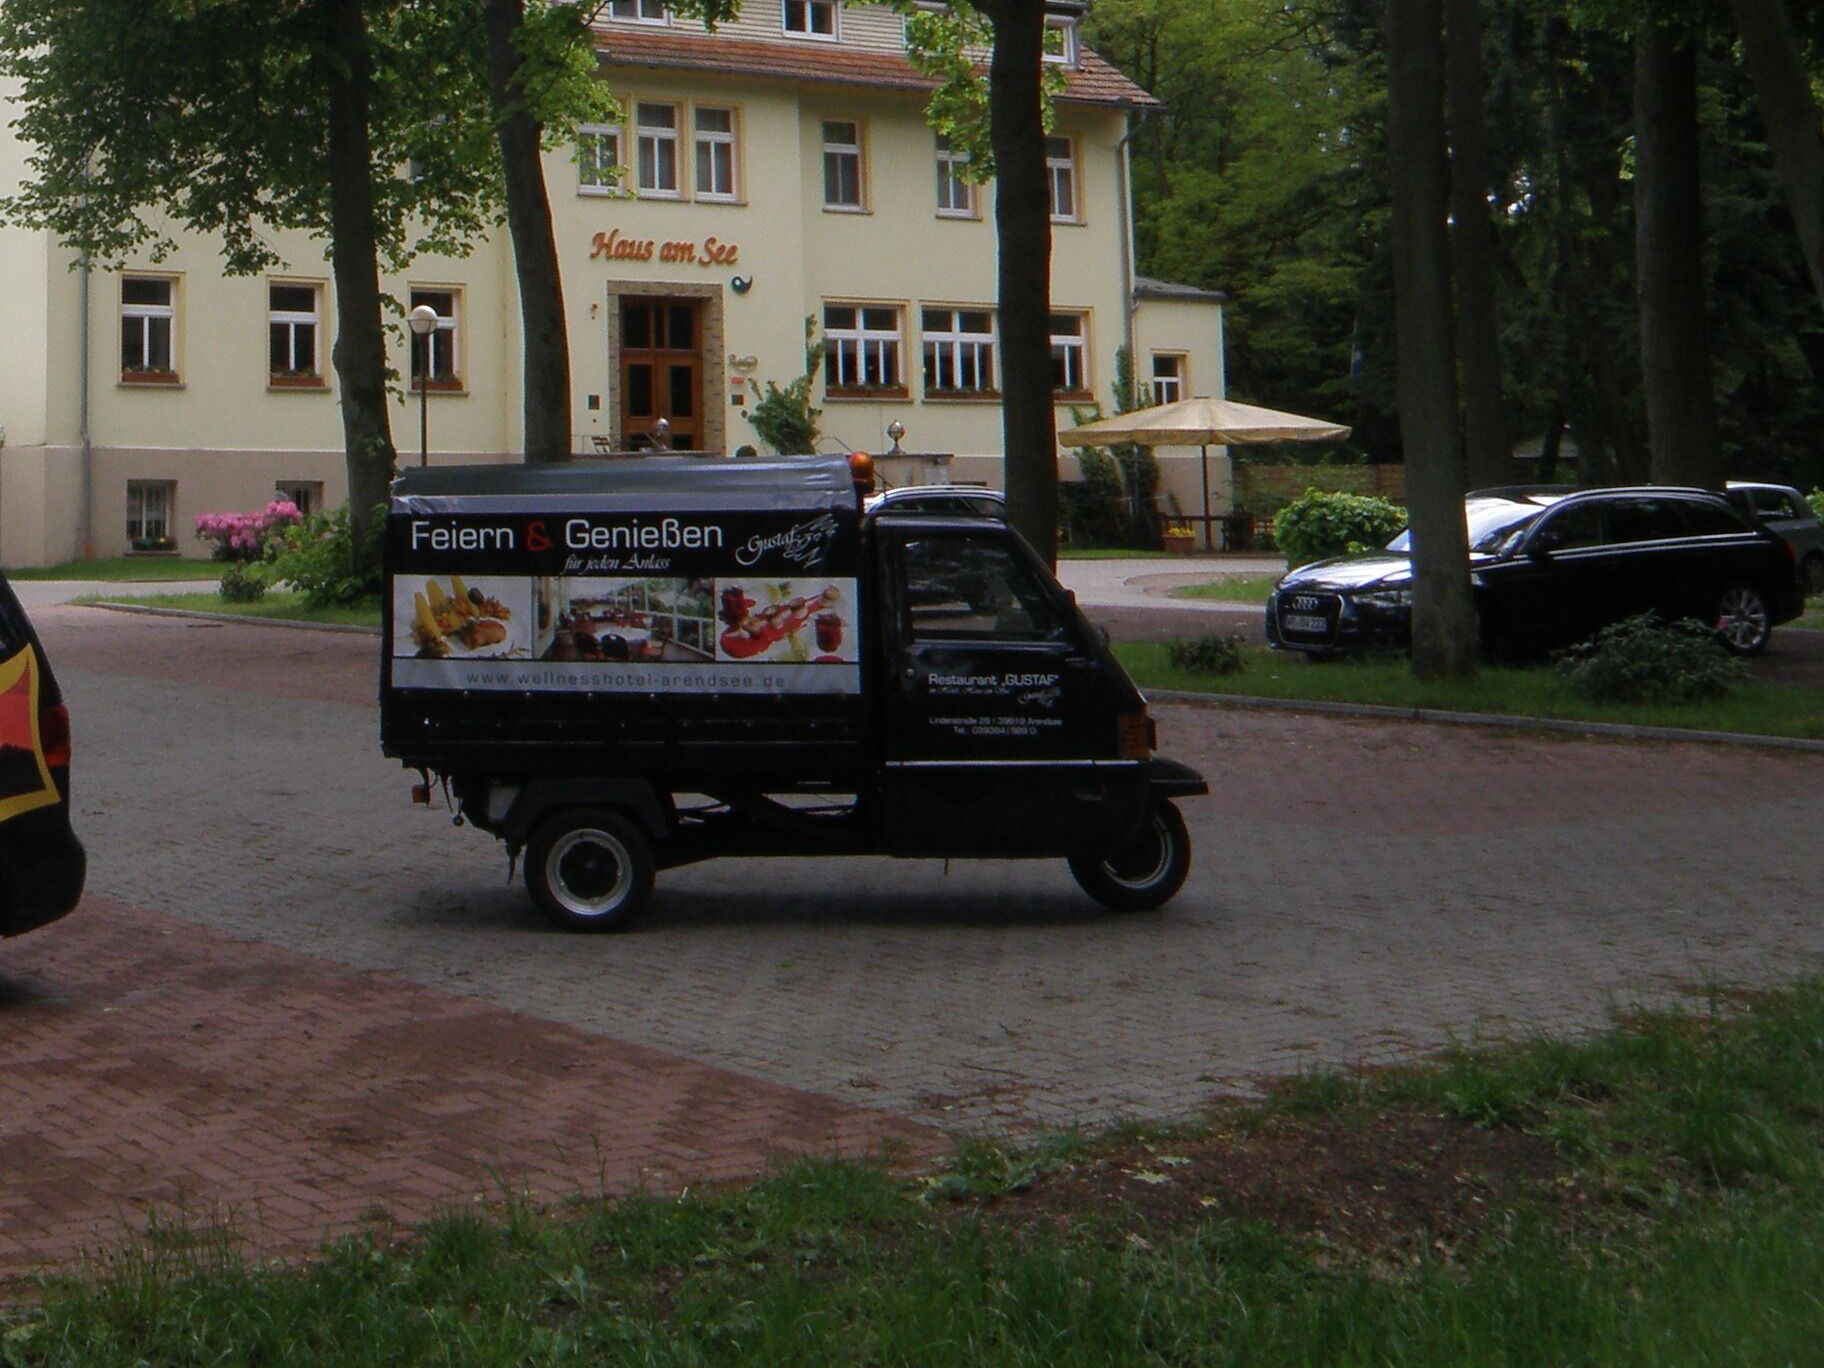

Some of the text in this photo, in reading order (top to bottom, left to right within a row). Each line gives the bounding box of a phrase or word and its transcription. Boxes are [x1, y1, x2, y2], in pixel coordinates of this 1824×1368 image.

[589, 228, 738, 266] Haus am See
[411, 518, 723, 551] Feiern & Genießen
[735, 516, 816, 567] Gustaf
[561, 553, 672, 575] für jeden Anlass
[466, 670, 786, 689] www.wellnesshotel-arendsee.de
[928, 673, 998, 686] Restaurant
